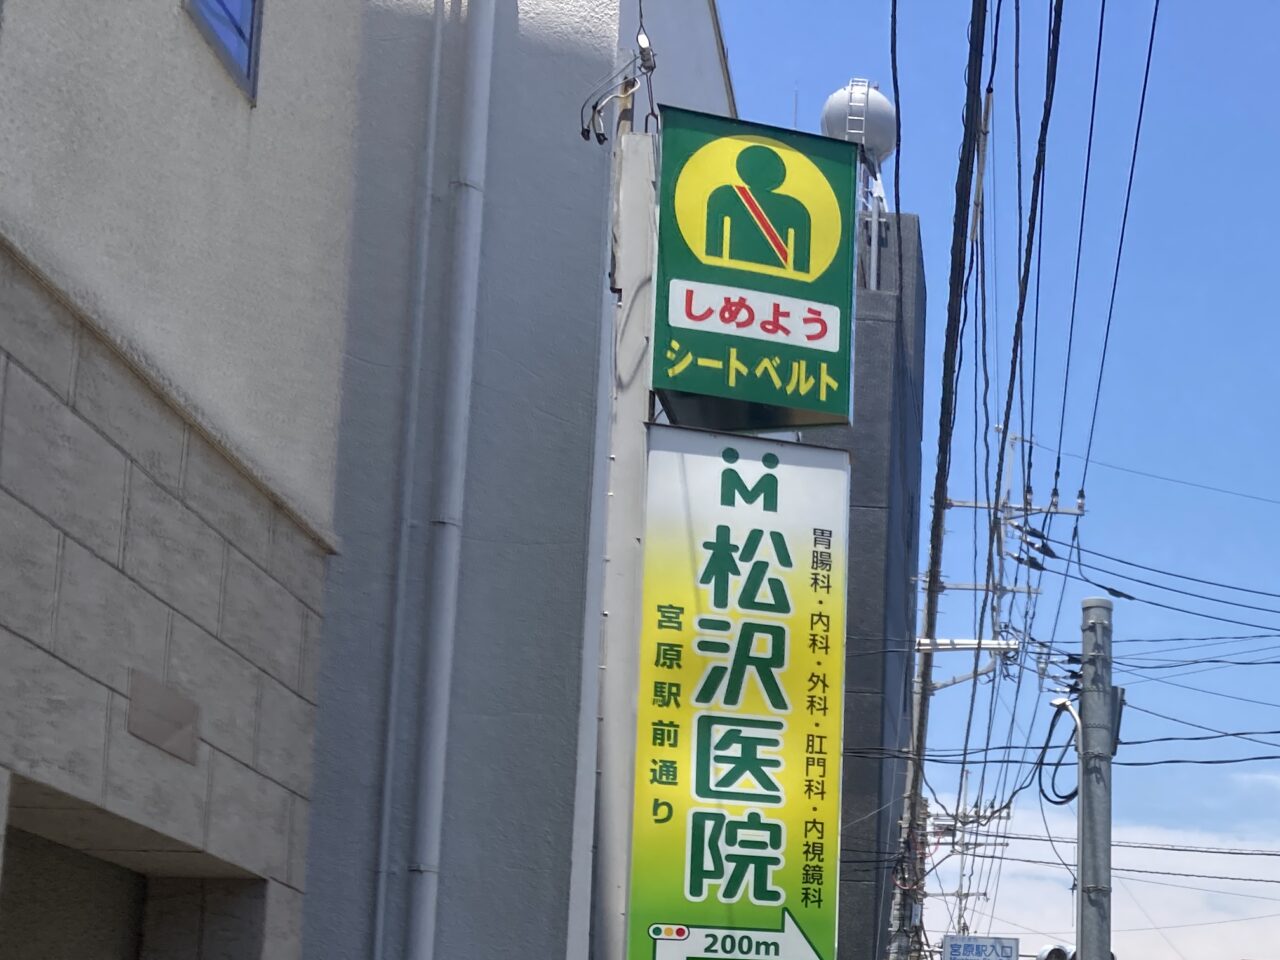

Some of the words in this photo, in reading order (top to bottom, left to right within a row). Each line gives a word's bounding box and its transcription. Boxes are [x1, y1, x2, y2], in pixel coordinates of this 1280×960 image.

[684, 288, 828, 342] しめよう
[665, 339, 839, 402] シートベルト
[649, 603, 684, 824] 宮原駅前通り
[690, 524, 793, 902] 松沢医院
[703, 933, 780, 957] 200m
[950, 943, 1013, 958] 宮原駅入口
